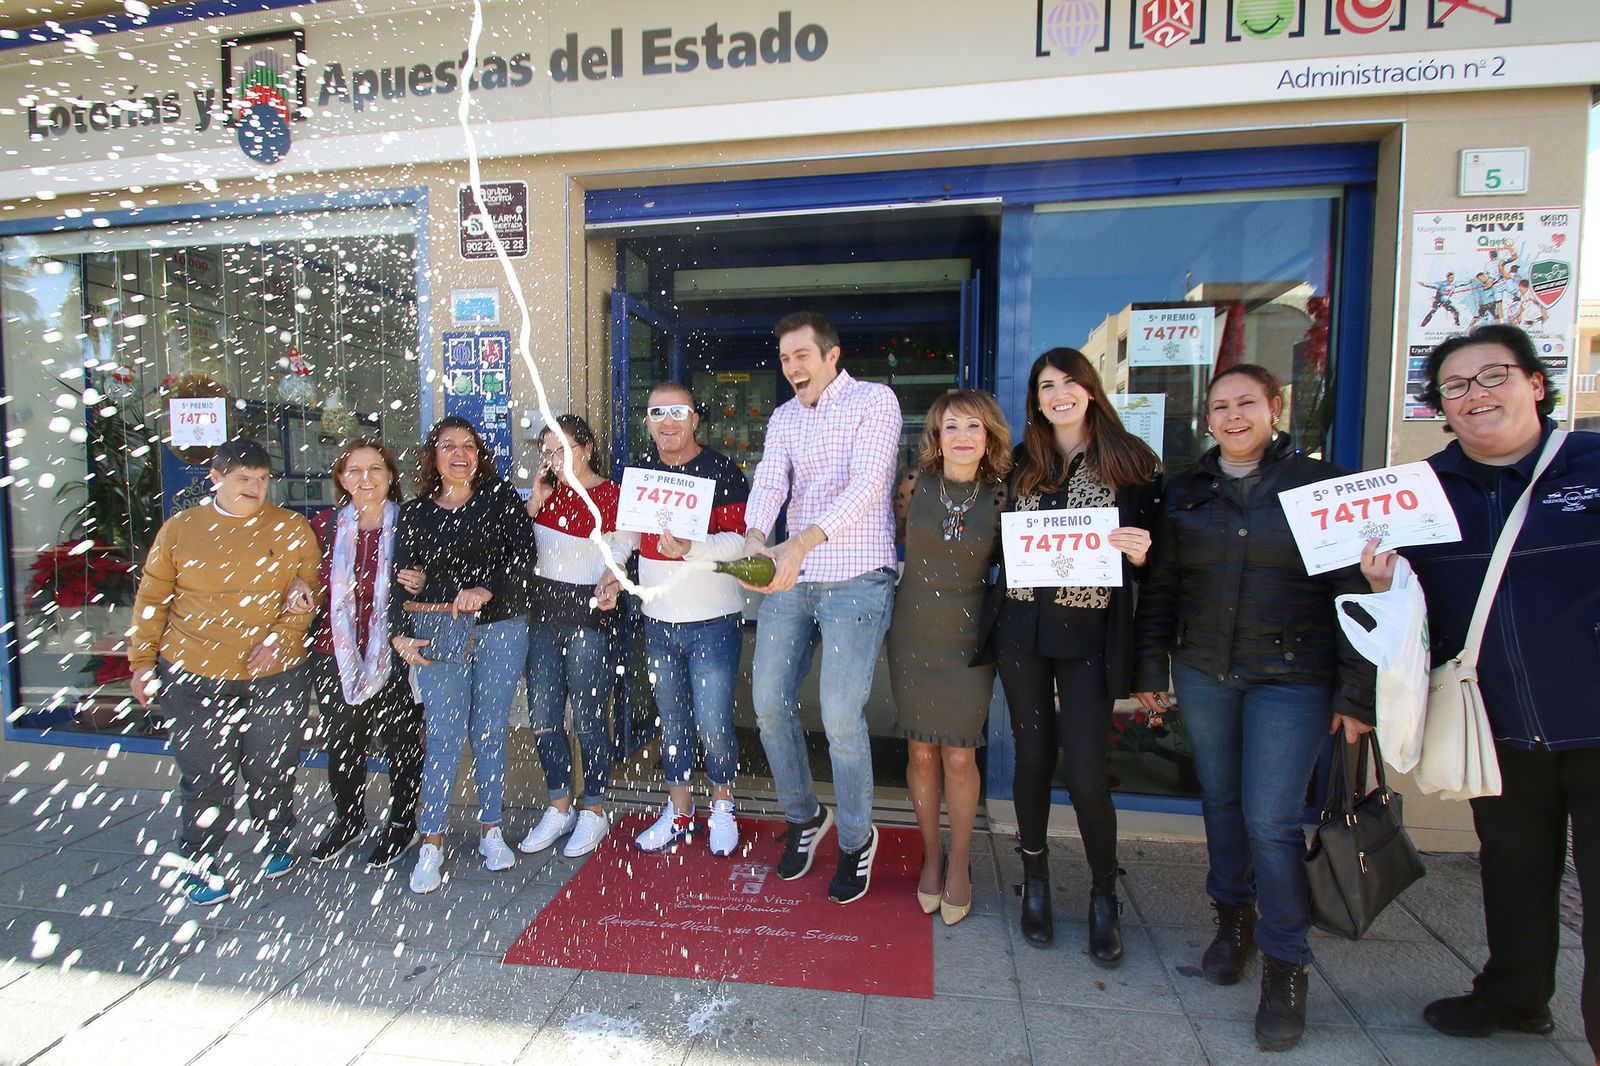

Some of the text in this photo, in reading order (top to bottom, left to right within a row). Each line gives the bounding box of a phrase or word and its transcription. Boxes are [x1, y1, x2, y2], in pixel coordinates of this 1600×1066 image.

[193, 88, 215, 132] y
[318, 49, 533, 112] Apuestas
[550, 28, 624, 83] del
[641, 10, 829, 76] Estado
[1277, 58, 1455, 89] Administración
[1492, 56, 1506, 77] 2
[1485, 168, 1502, 189] 5
[1466, 212, 1525, 222] LAMPARAS
[1465, 222, 1524, 232] MIVI
[466, 241, 483, 252] 902
[513, 239, 524, 249] 22
[1160, 313, 1196, 322] PREMIO
[1143, 325, 1200, 341] 74770
[179, 412, 217, 424] 7470
[657, 475, 695, 489] PREMIO
[1334, 473, 1398, 497] PREMIO
[635, 486, 698, 510] 74770
[1311, 489, 1419, 531] 74770
[1043, 515, 1092, 528] PREMIO
[1019, 532, 1101, 553] 74770
[754, 925, 798, 938] Valor
[801, 928, 860, 943] Seguro
